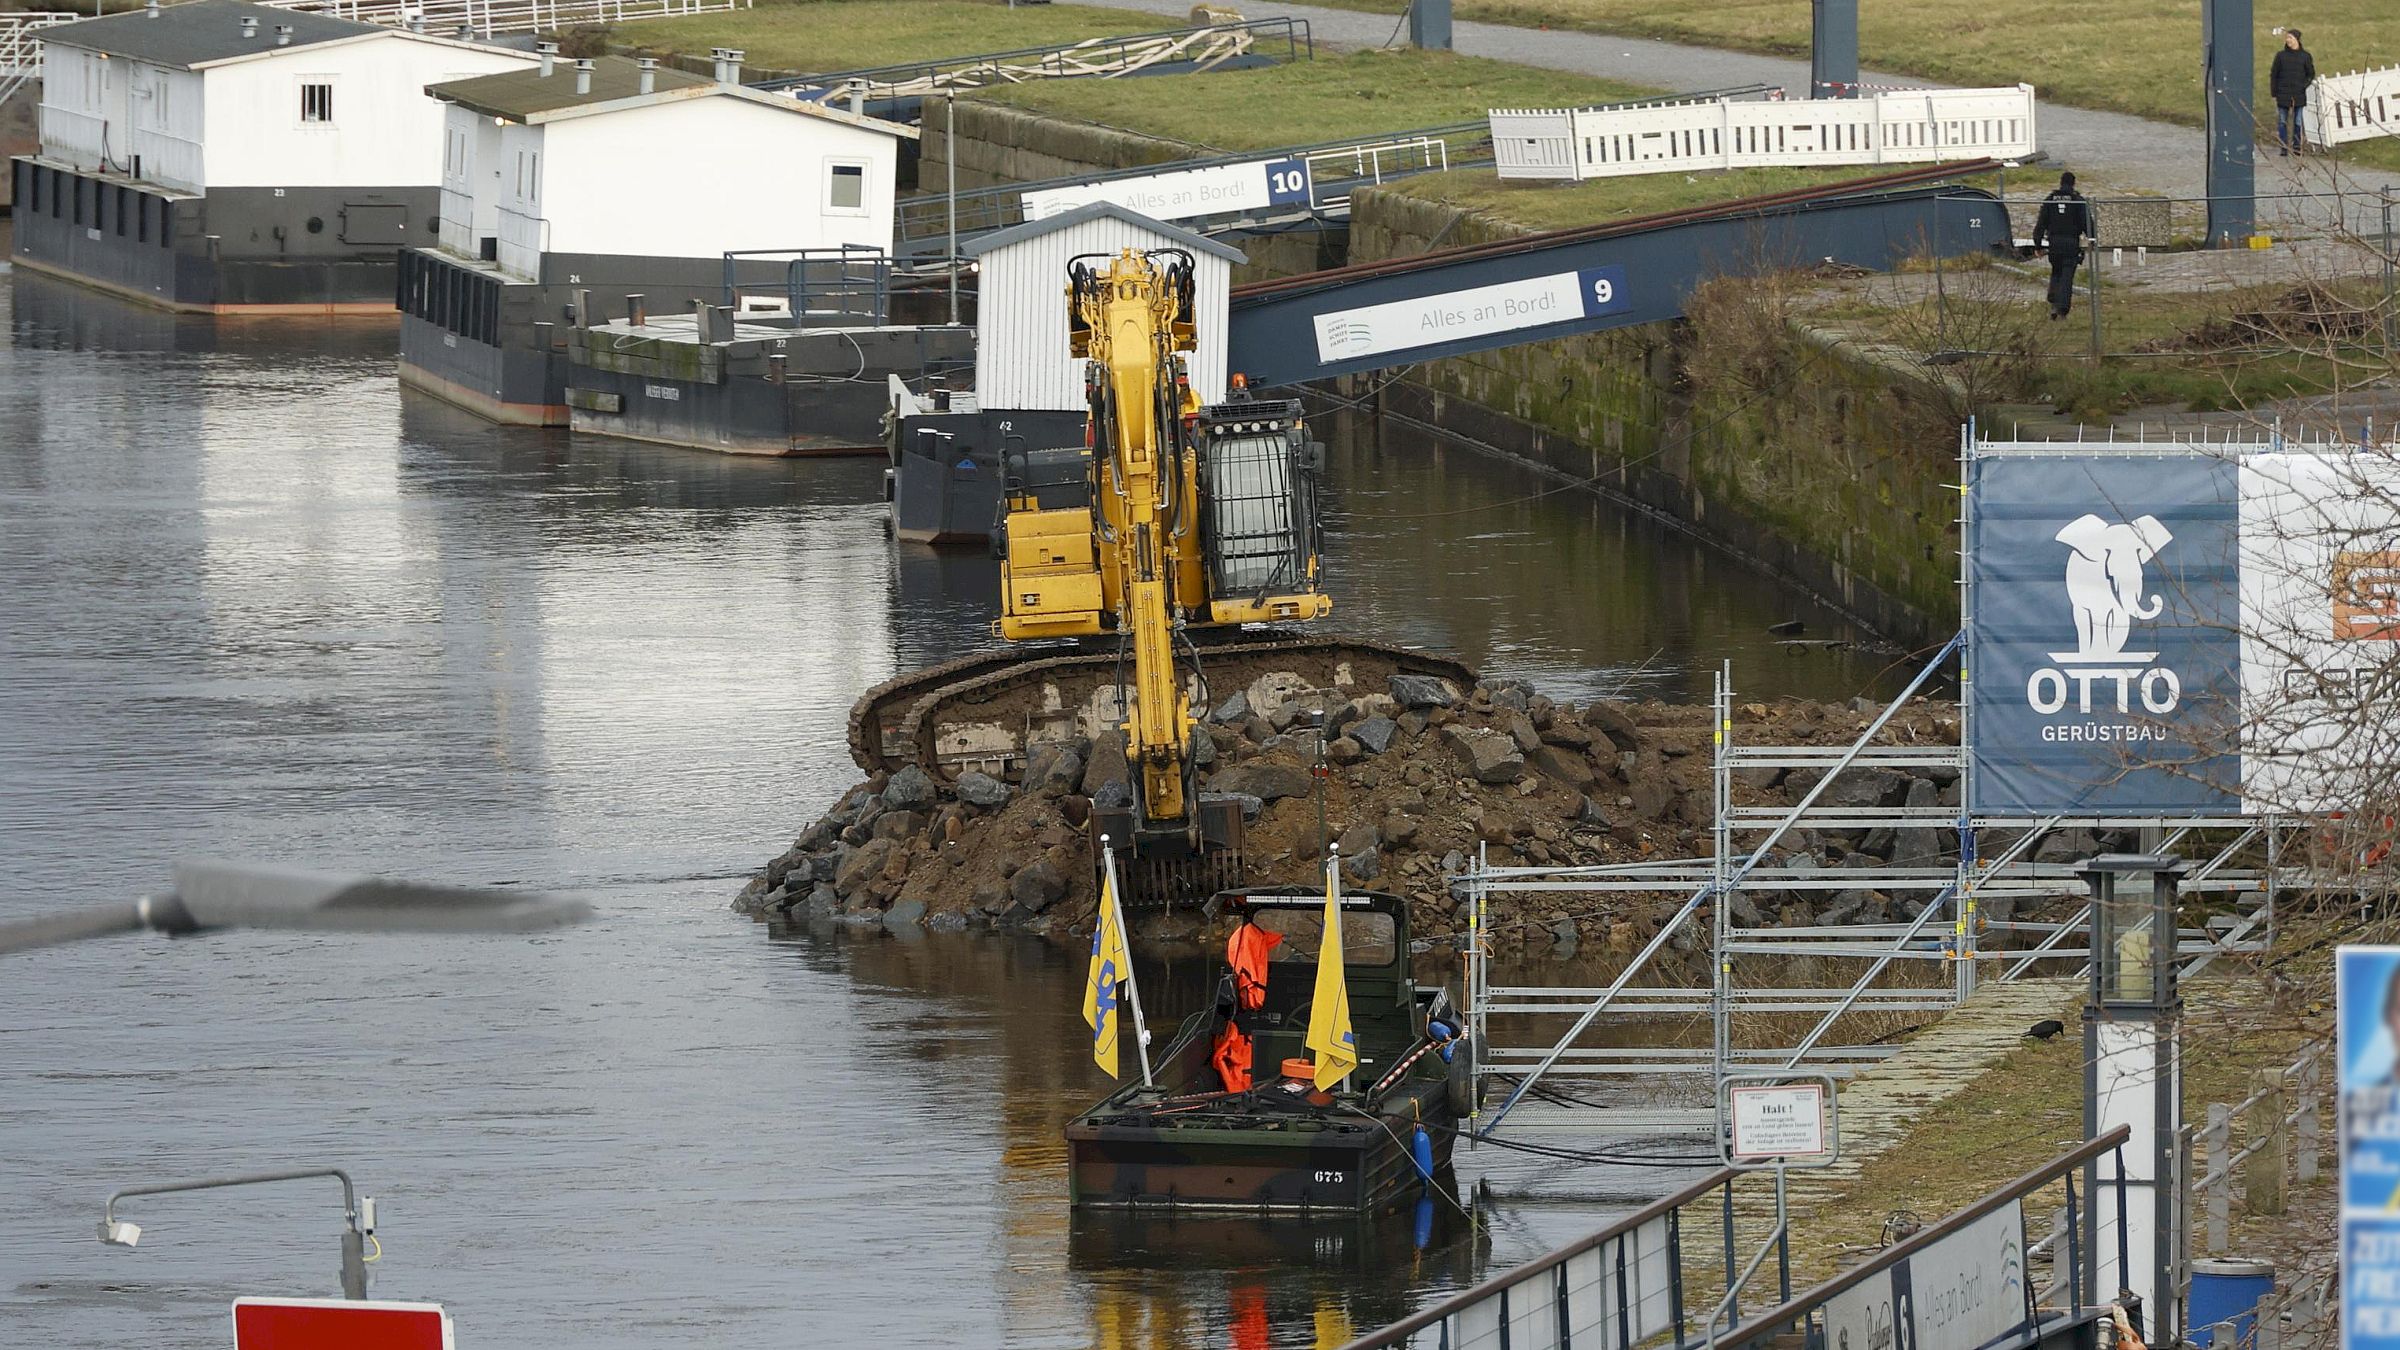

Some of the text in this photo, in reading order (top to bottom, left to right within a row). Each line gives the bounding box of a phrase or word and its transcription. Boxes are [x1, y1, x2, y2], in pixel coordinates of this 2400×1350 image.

[1272, 170, 1303, 193] 10
[1125, 181, 1246, 211] Alles an Bord!
[1969, 218, 1981, 228] 22
[1594, 279, 1613, 303] 9
[1421, 291, 1556, 330] Alles an Bord!
[776, 339, 787, 348] 22
[2027, 667, 2180, 714] OTTO
[2041, 722, 2167, 742] GERÜSTBAU
[1314, 1170, 1344, 1183] 675
[1923, 1283, 1946, 1329] Alles
[1947, 1287, 1959, 1322] an
[1959, 1262, 1983, 1316] Bord!
[1899, 1293, 1911, 1350] 6
